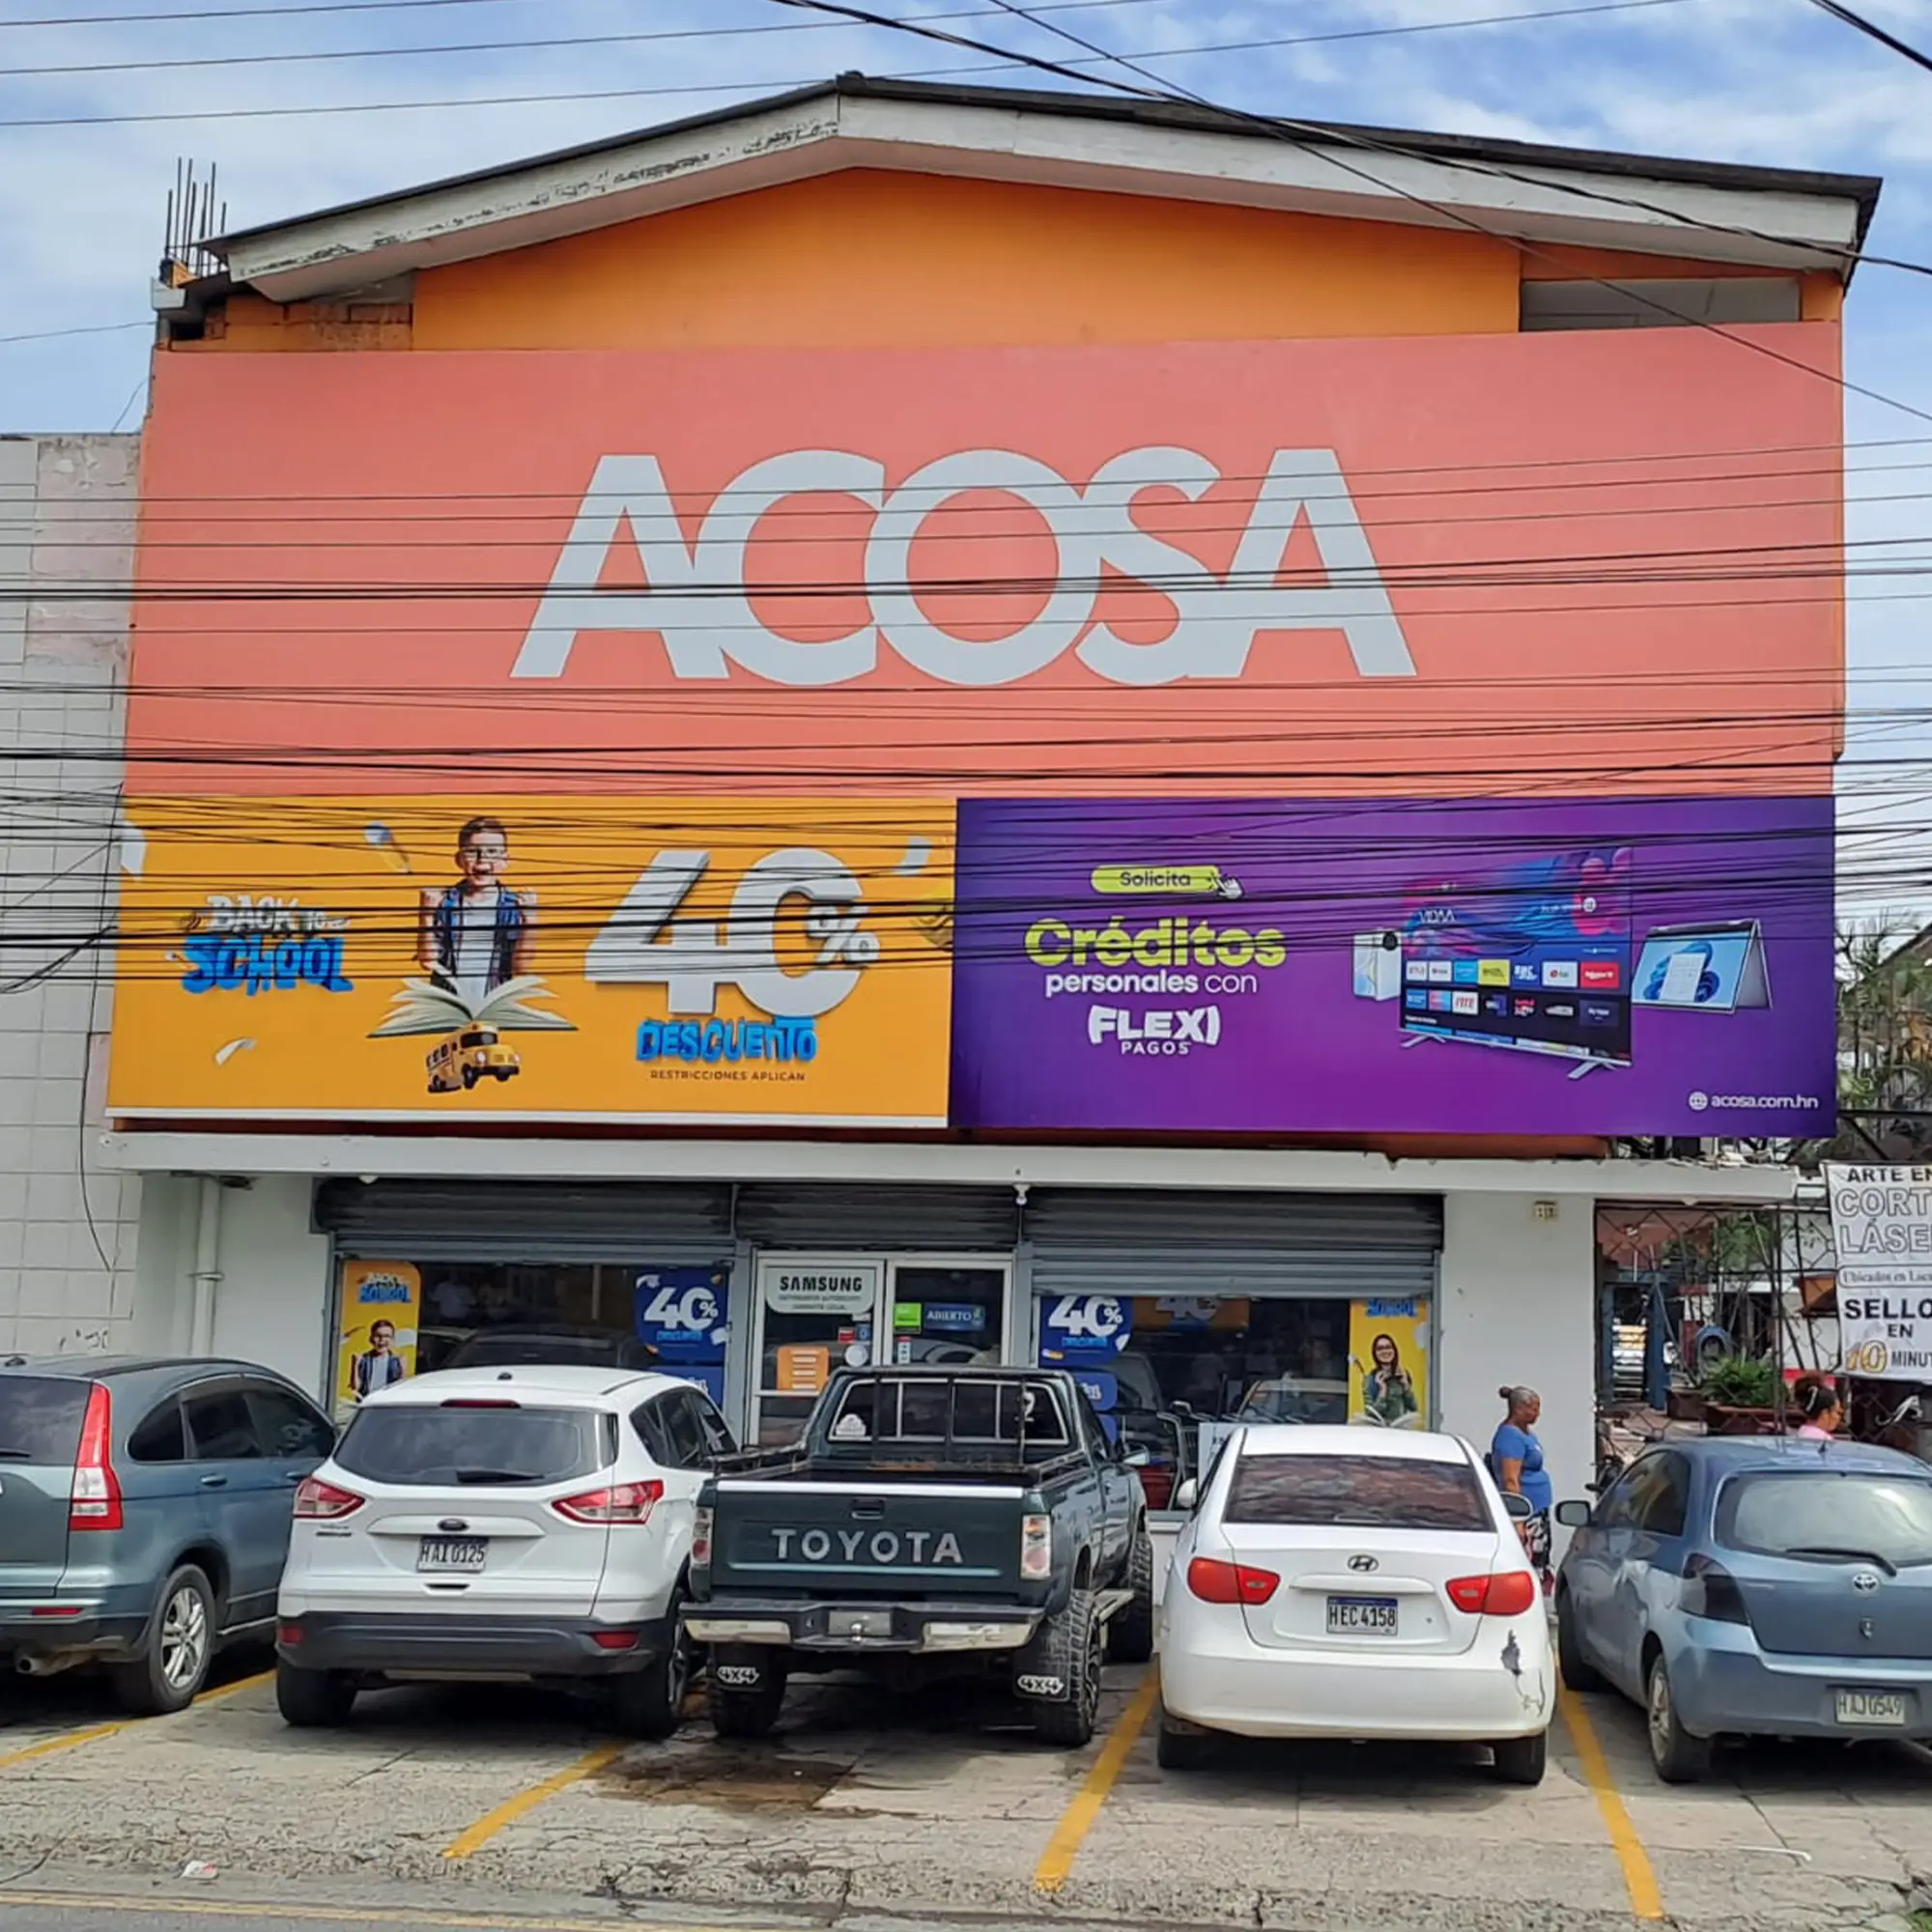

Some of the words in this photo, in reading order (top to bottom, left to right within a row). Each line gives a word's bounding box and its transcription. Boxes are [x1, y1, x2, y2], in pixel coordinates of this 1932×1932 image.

[510, 445, 1417, 686] ACOSA
[1120, 870, 1191, 887] Solicita
[1025, 916, 1287, 967] Créditos
[181, 933, 355, 996] SCHOOL
[1045, 969, 1199, 998] personales
[1205, 974, 1258, 993] con
[1121, 1040, 1191, 1055] PAGOS
[650, 1069, 748, 1081] RESTRICCIONES
[752, 1070, 806, 1082] APLICAN
[1711, 1094, 1819, 1109] acosa.com.hn
[1847, 1167, 1904, 1183] ARTE
[1839, 1217, 1932, 1254] LÁSE
[780, 1275, 863, 1293] SAMSUNG
[927, 1309, 973, 1322] ABIERTO
[1887, 1322, 1914, 1339] EN
[1845, 1339, 1889, 1374] 10
[772, 1527, 963, 1565] TOYOTA
